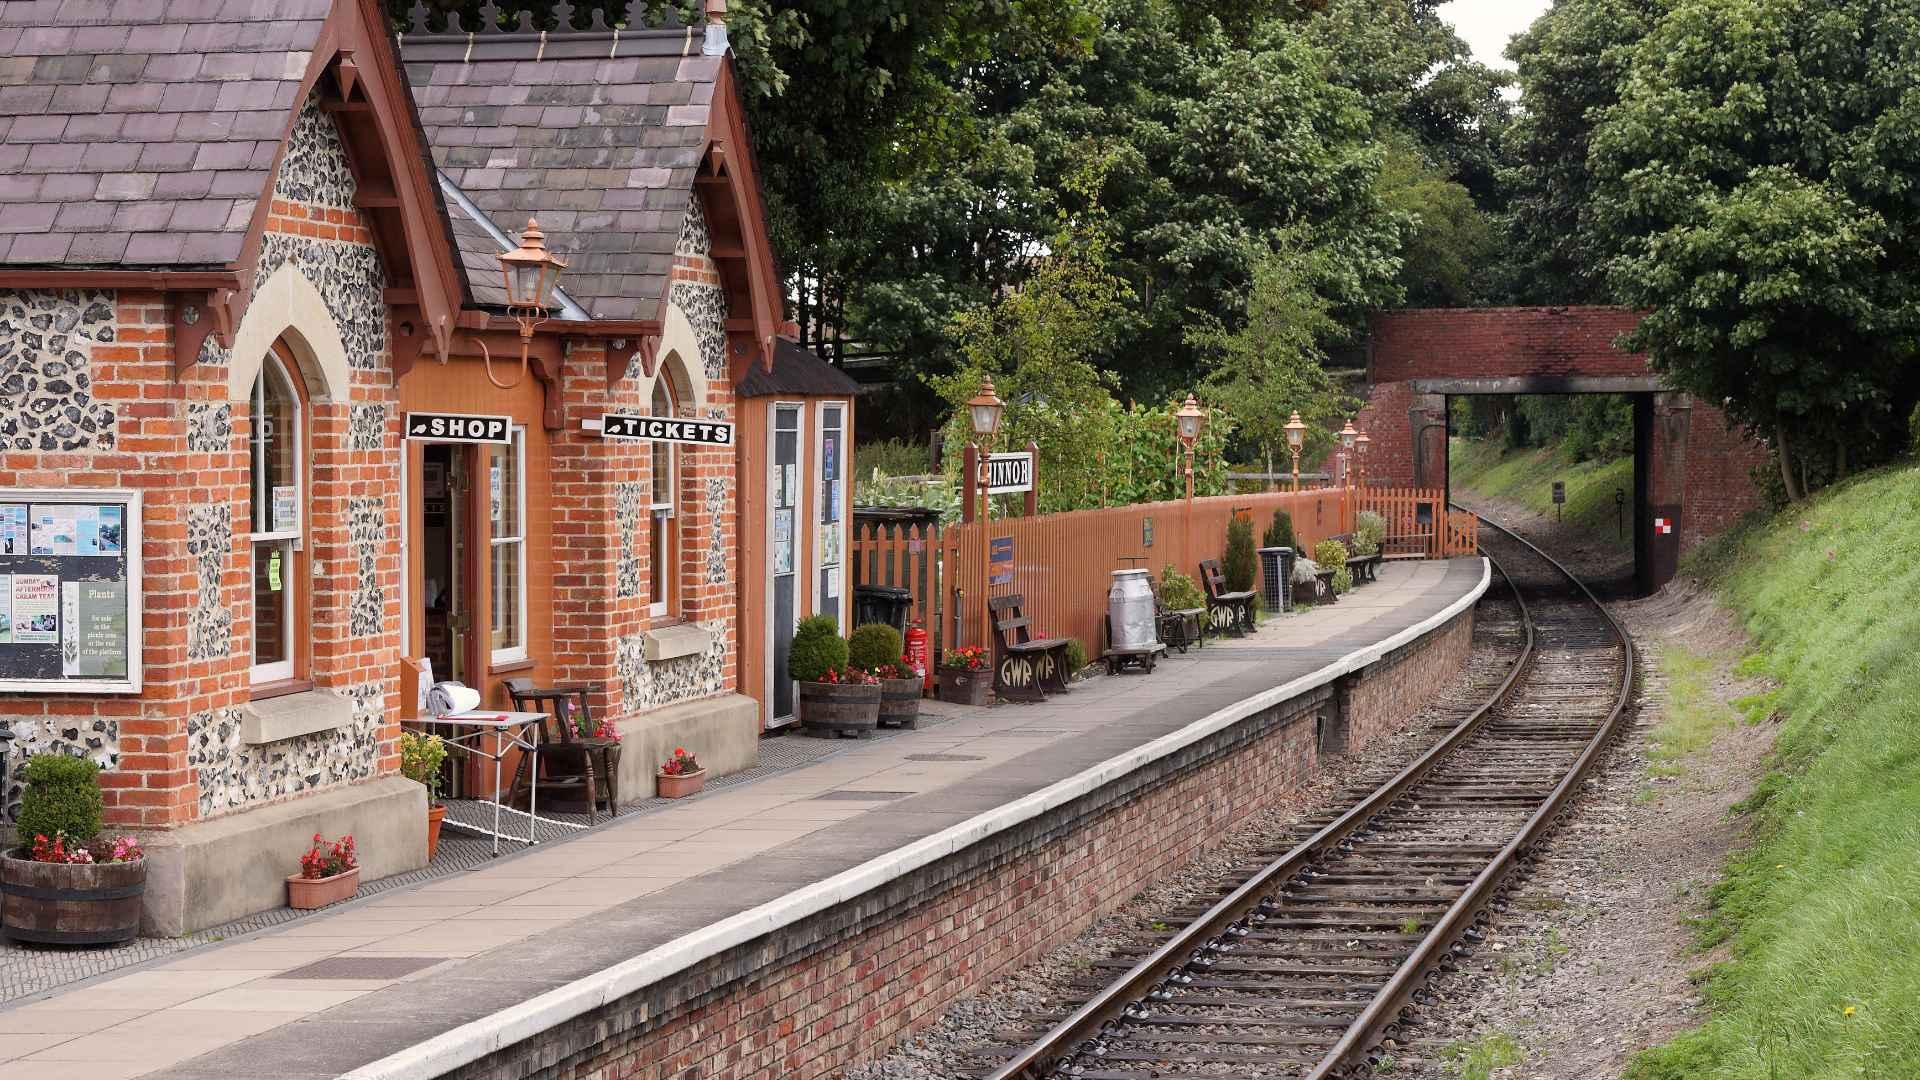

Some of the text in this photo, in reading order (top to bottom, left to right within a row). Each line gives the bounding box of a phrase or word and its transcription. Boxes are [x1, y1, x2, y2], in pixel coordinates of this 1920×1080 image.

[430, 418, 503, 438] SHOP
[623, 419, 728, 442] TICKETS
[88, 589, 116, 599] Plants
[1210, 605, 1234, 628] GWR
[1001, 657, 1032, 688] GWR
